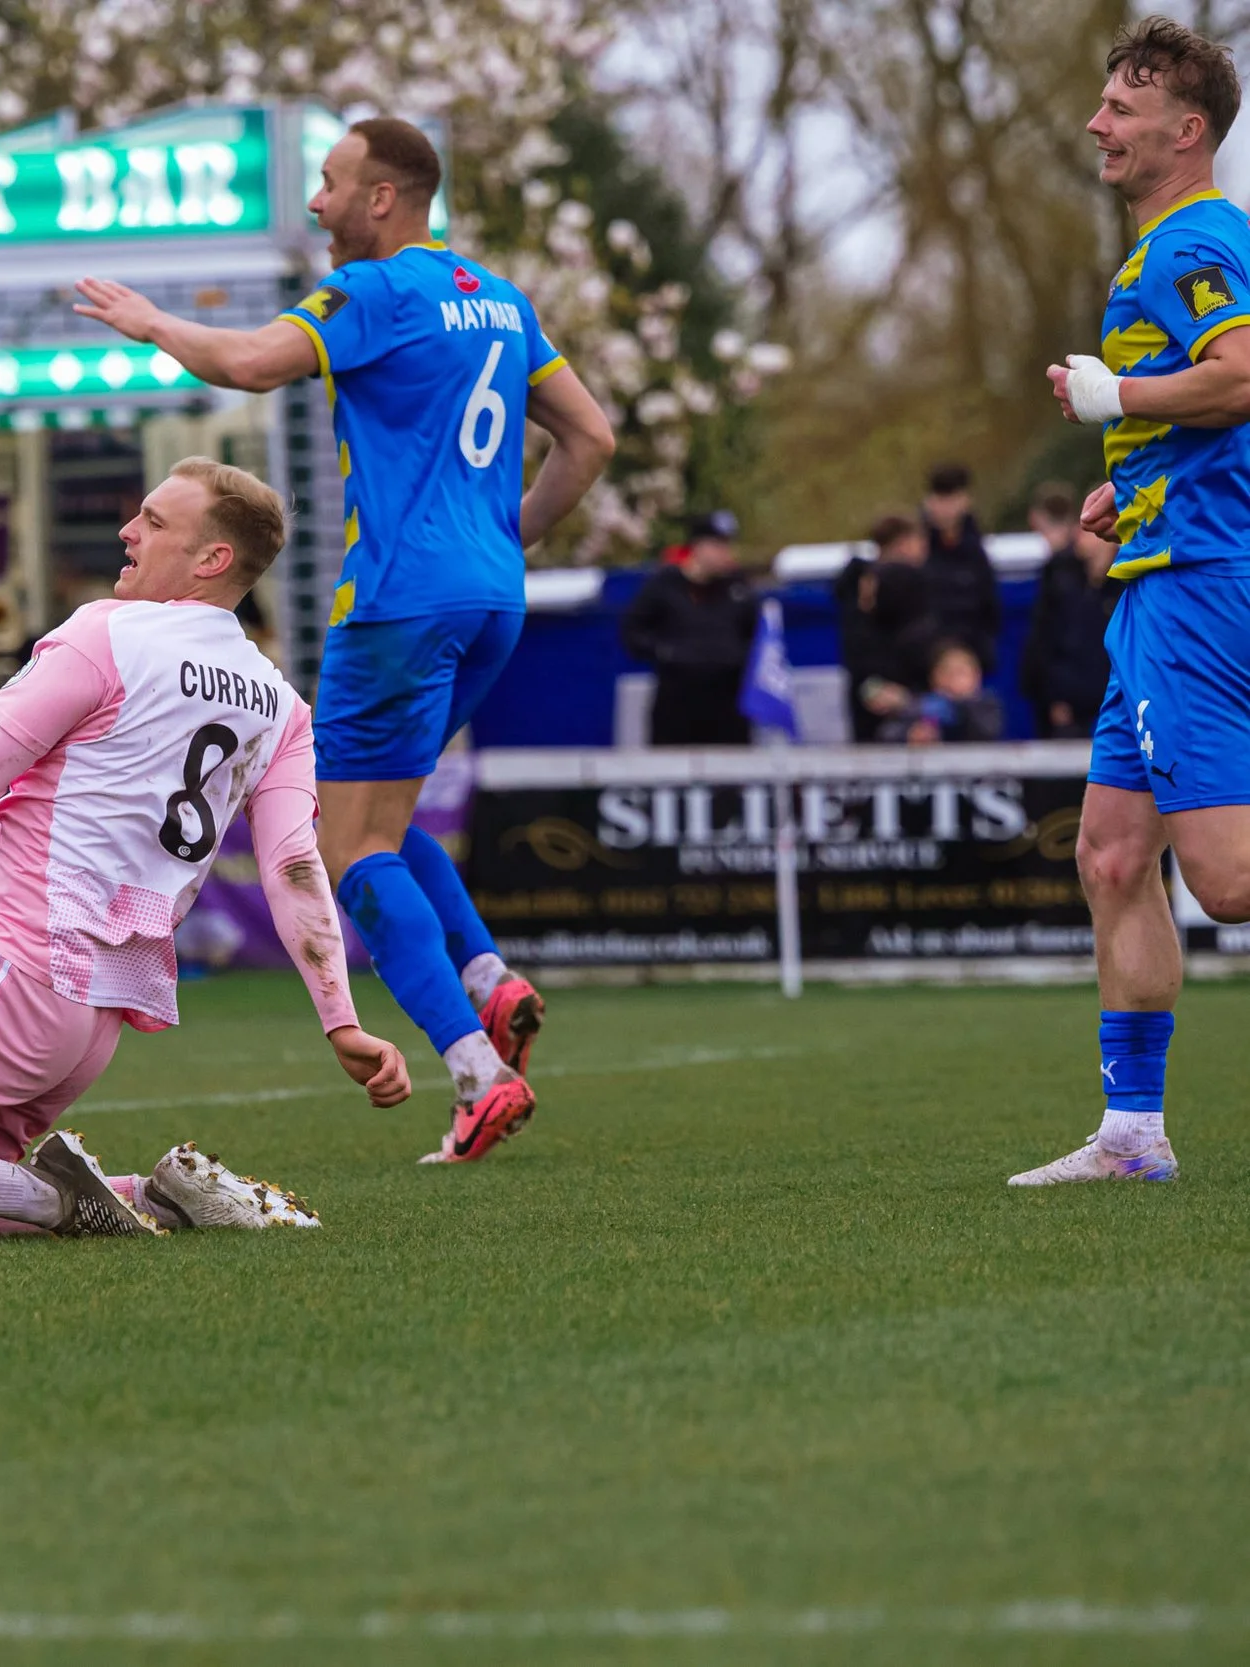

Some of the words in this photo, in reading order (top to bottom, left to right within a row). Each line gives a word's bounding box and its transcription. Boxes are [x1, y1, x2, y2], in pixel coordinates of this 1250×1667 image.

[55, 141, 244, 231] BAR
[458, 340, 506, 469] 6
[180, 660, 279, 722] CURRAN
[158, 723, 239, 863] 8
[598, 780, 1027, 850] SILLETTS
[678, 842, 810, 875] FUNERL
